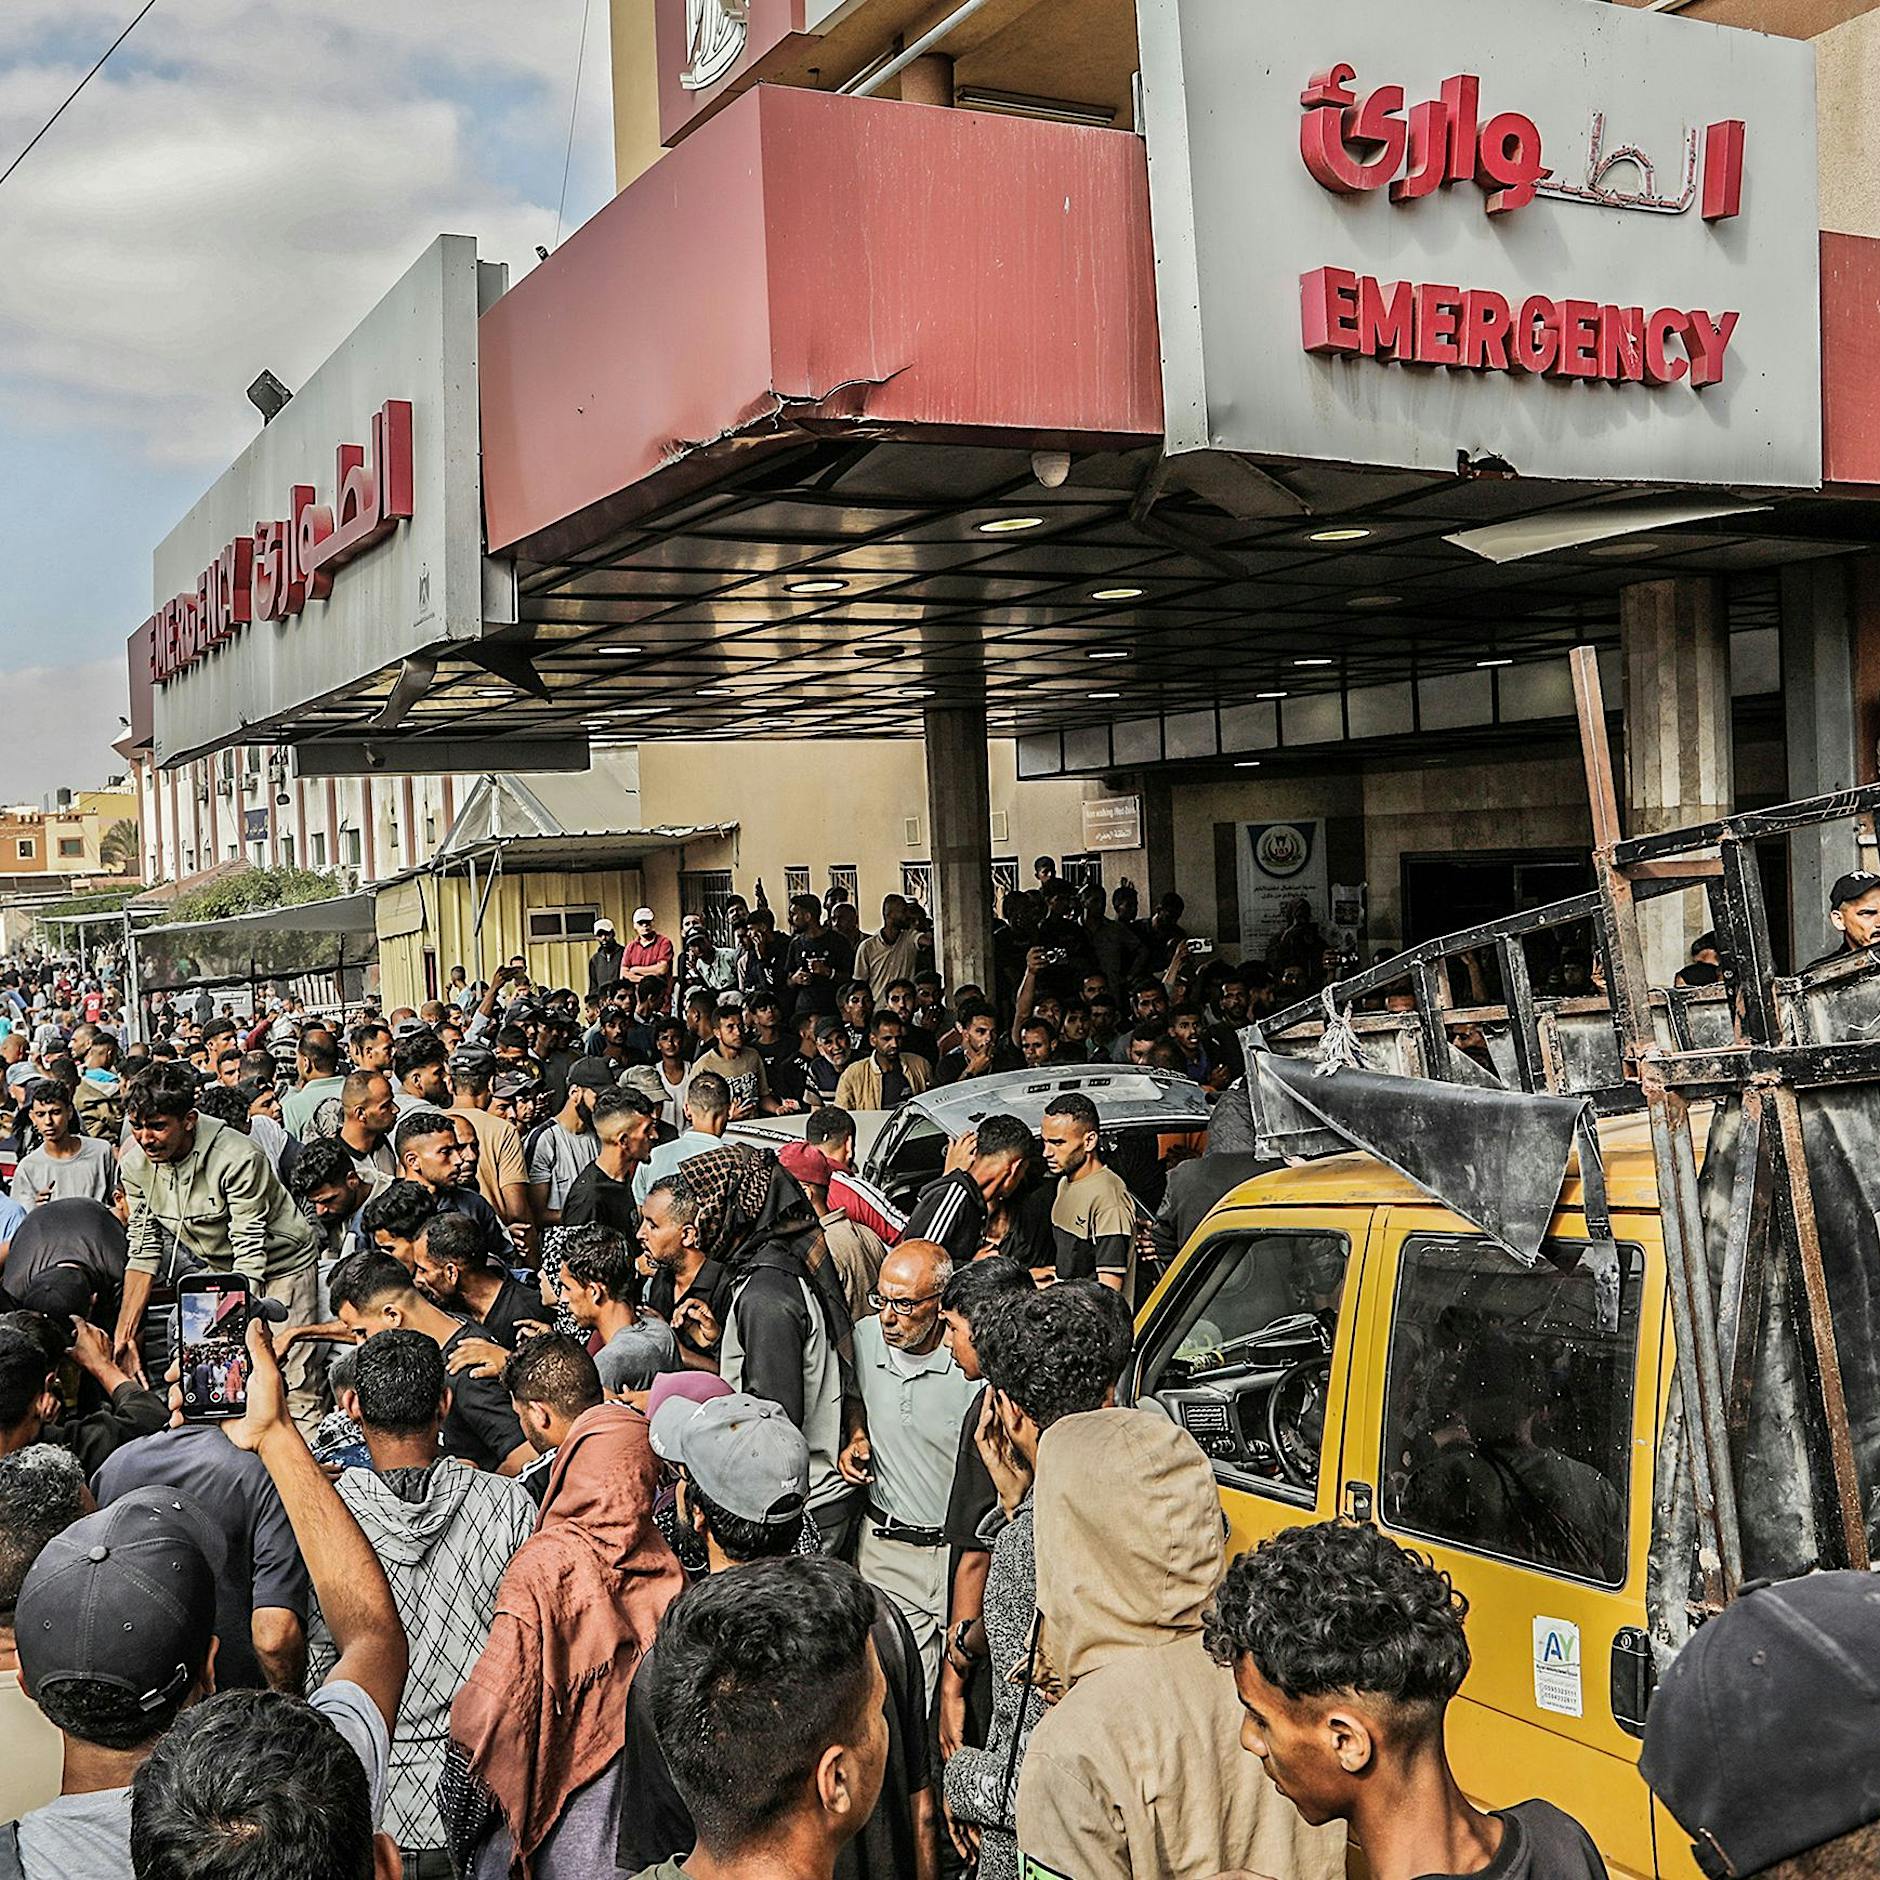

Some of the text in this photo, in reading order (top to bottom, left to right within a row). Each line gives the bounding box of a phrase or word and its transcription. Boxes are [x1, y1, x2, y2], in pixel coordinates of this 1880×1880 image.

[1300, 63, 1745, 221] الطوارئ
[1300, 266, 1740, 388] EMERGENCY
[252, 399, 414, 622] الطوارئ
[150, 537, 254, 684] EMERGENCY
[1544, 1631, 1575, 1662] AY
